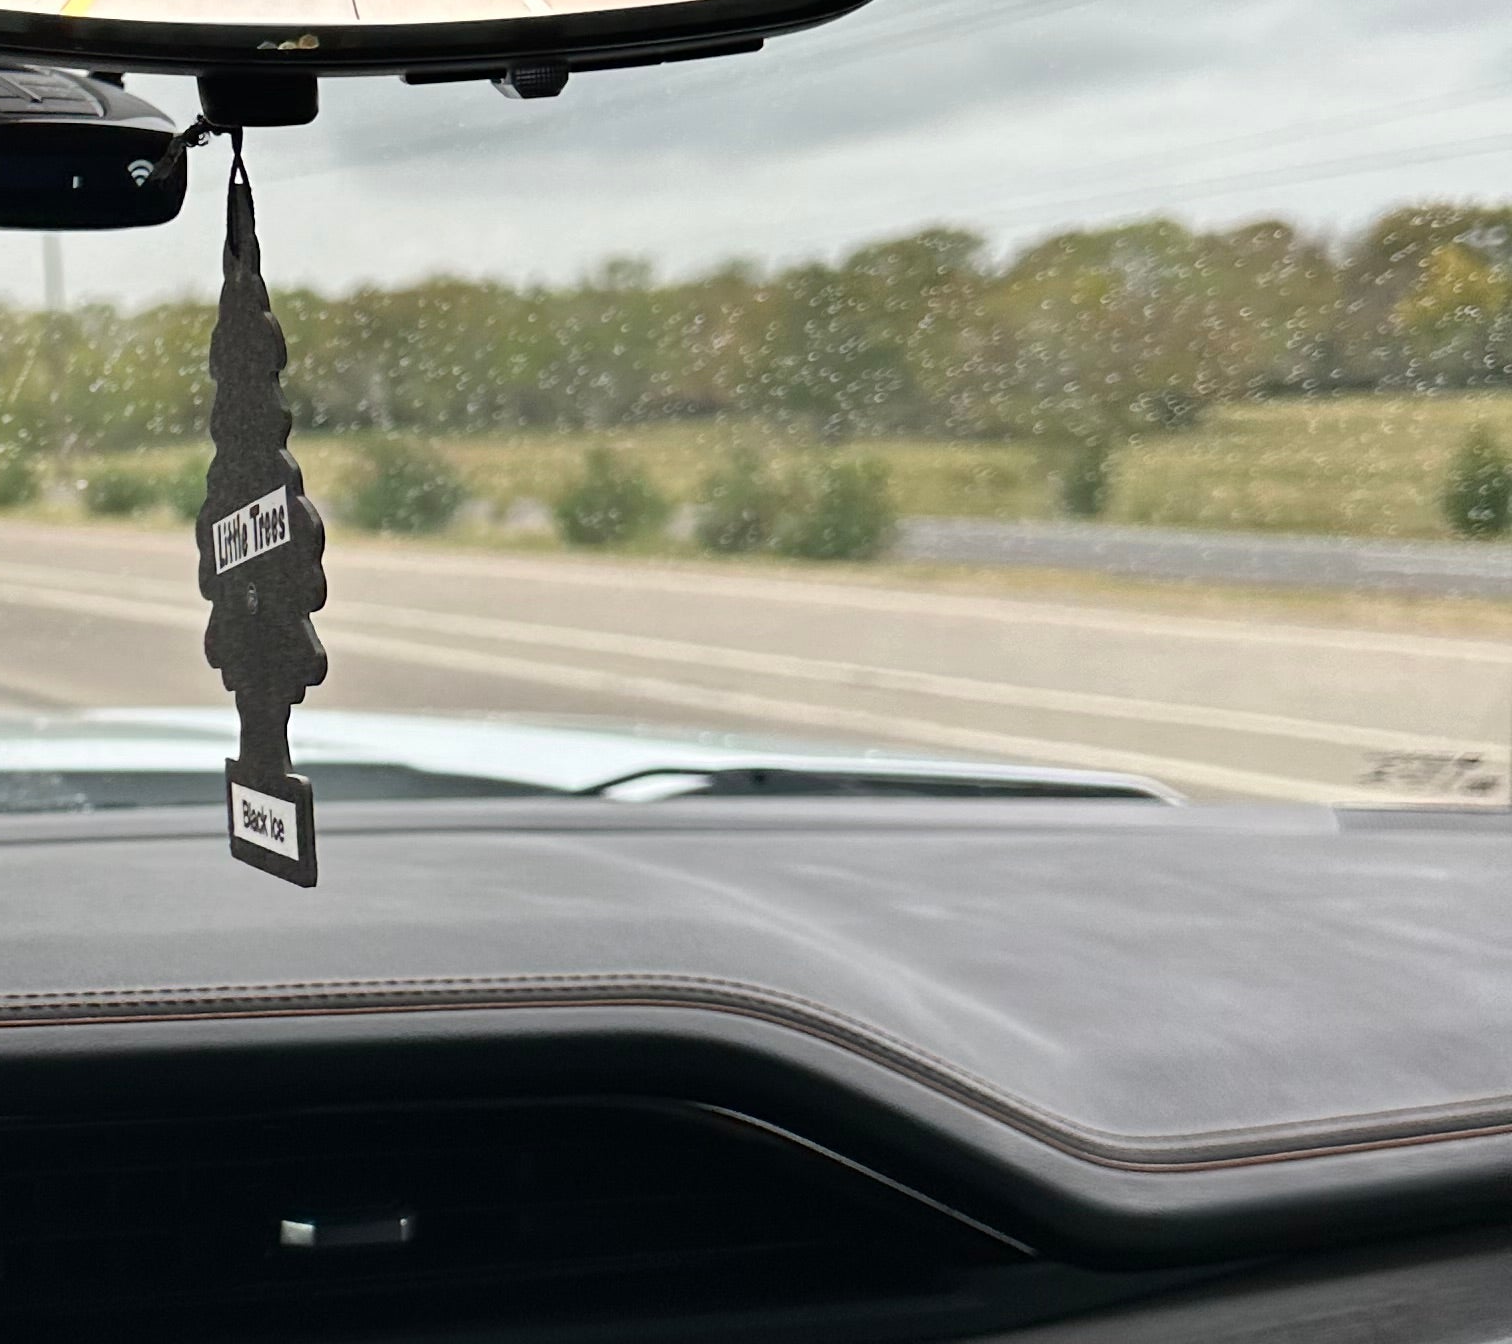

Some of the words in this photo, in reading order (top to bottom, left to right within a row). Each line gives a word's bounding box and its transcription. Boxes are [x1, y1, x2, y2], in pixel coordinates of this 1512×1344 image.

[218, 513, 248, 569] Little
[249, 504, 285, 552] Trees
[242, 798, 268, 837] Black
[269, 808, 285, 843] Ice
